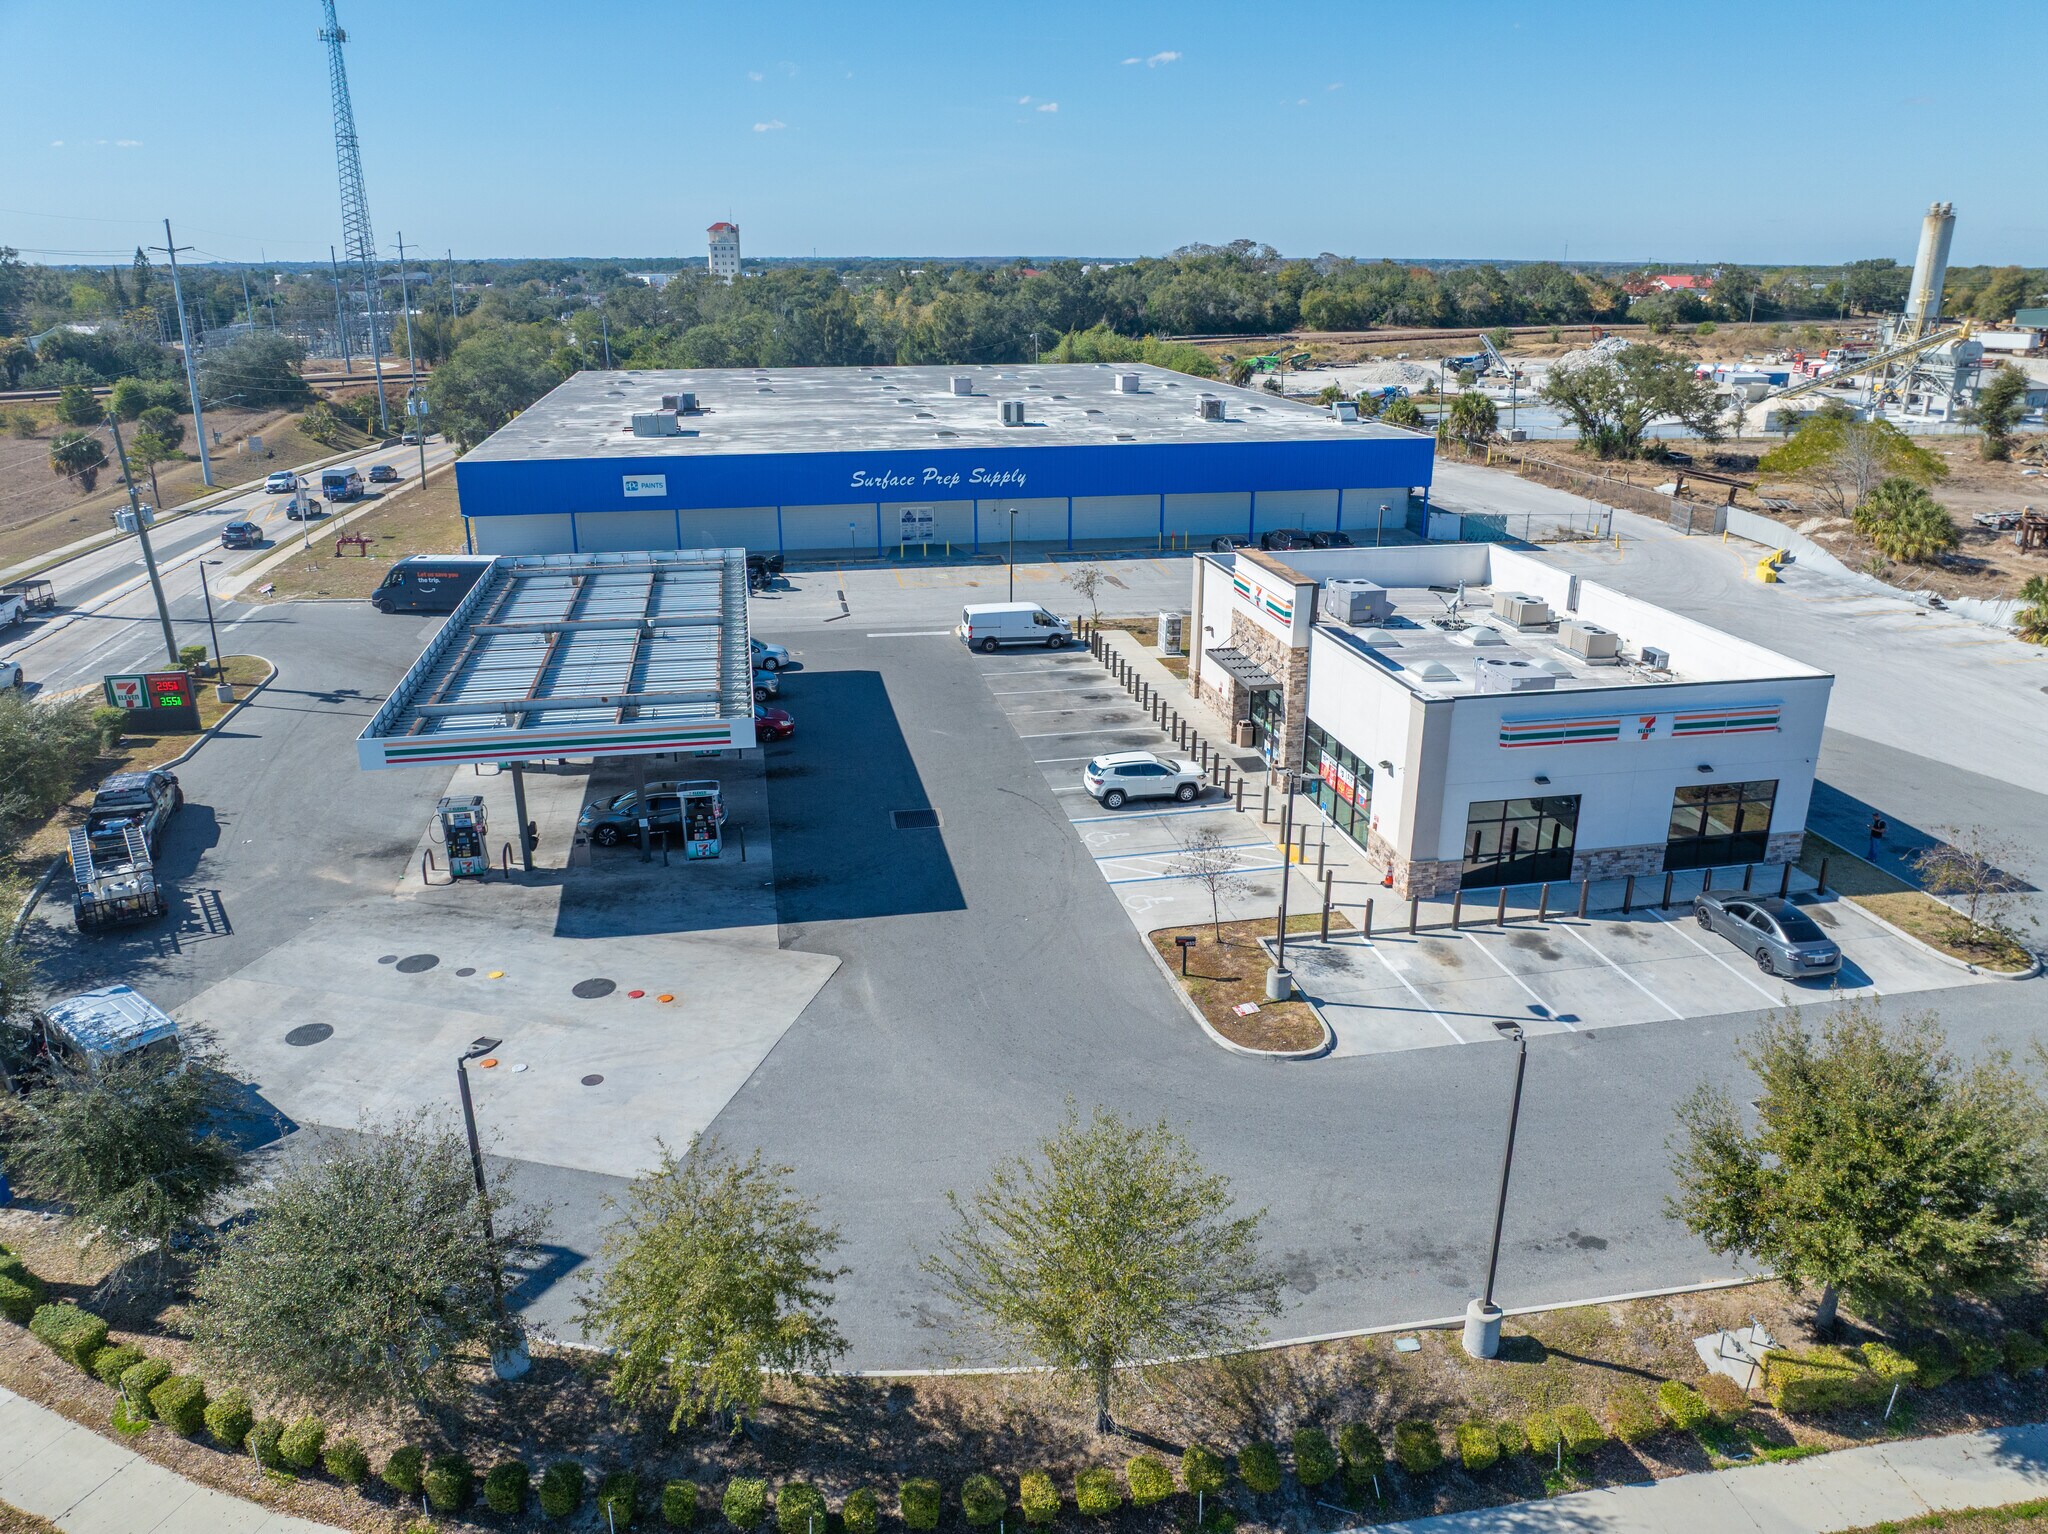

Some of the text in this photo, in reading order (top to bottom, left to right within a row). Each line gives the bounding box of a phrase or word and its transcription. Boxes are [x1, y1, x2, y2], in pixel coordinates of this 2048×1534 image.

[850, 467, 1027, 489] Surface Prep Supply
[116, 682, 137, 707] 7
[1639, 716, 1656, 740] 7
